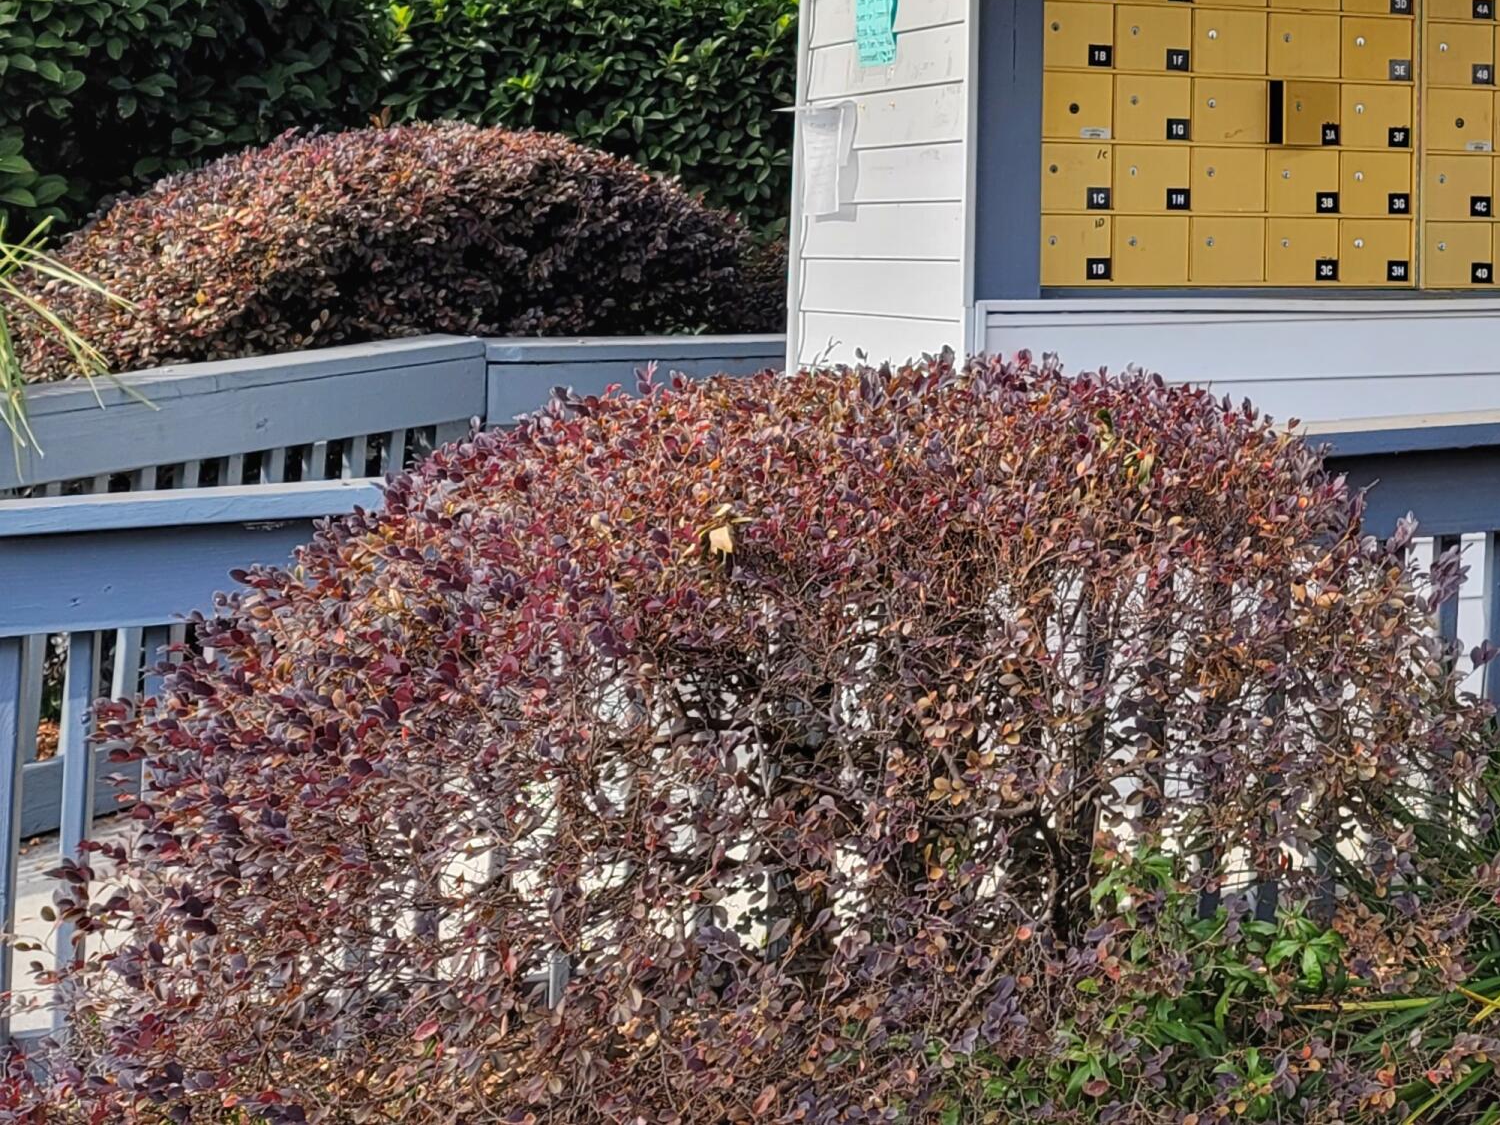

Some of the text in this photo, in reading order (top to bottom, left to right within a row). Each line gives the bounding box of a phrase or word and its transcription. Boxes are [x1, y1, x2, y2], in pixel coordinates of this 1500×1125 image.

[1476, 4, 1489, 14] 4A
[1094, 50, 1107, 61] 1B
[1172, 55, 1184, 66] 1F
[1394, 65, 1406, 76] 3E
[1476, 69, 1489, 80] 4B
[1172, 124, 1184, 135] 1G
[1325, 129, 1336, 140] 3A
[1393, 131, 1405, 142] 3F
[1092, 192, 1105, 204] 1C
[1172, 194, 1185, 205] 1H
[1321, 197, 1334, 208] 3B
[1393, 198, 1406, 209] 3G
[1474, 201, 1487, 212] 4C
[1092, 263, 1105, 275] 1D
[1320, 264, 1333, 276] 3C
[1391, 265, 1405, 277] 3H
[1475, 268, 1488, 279] 4D
